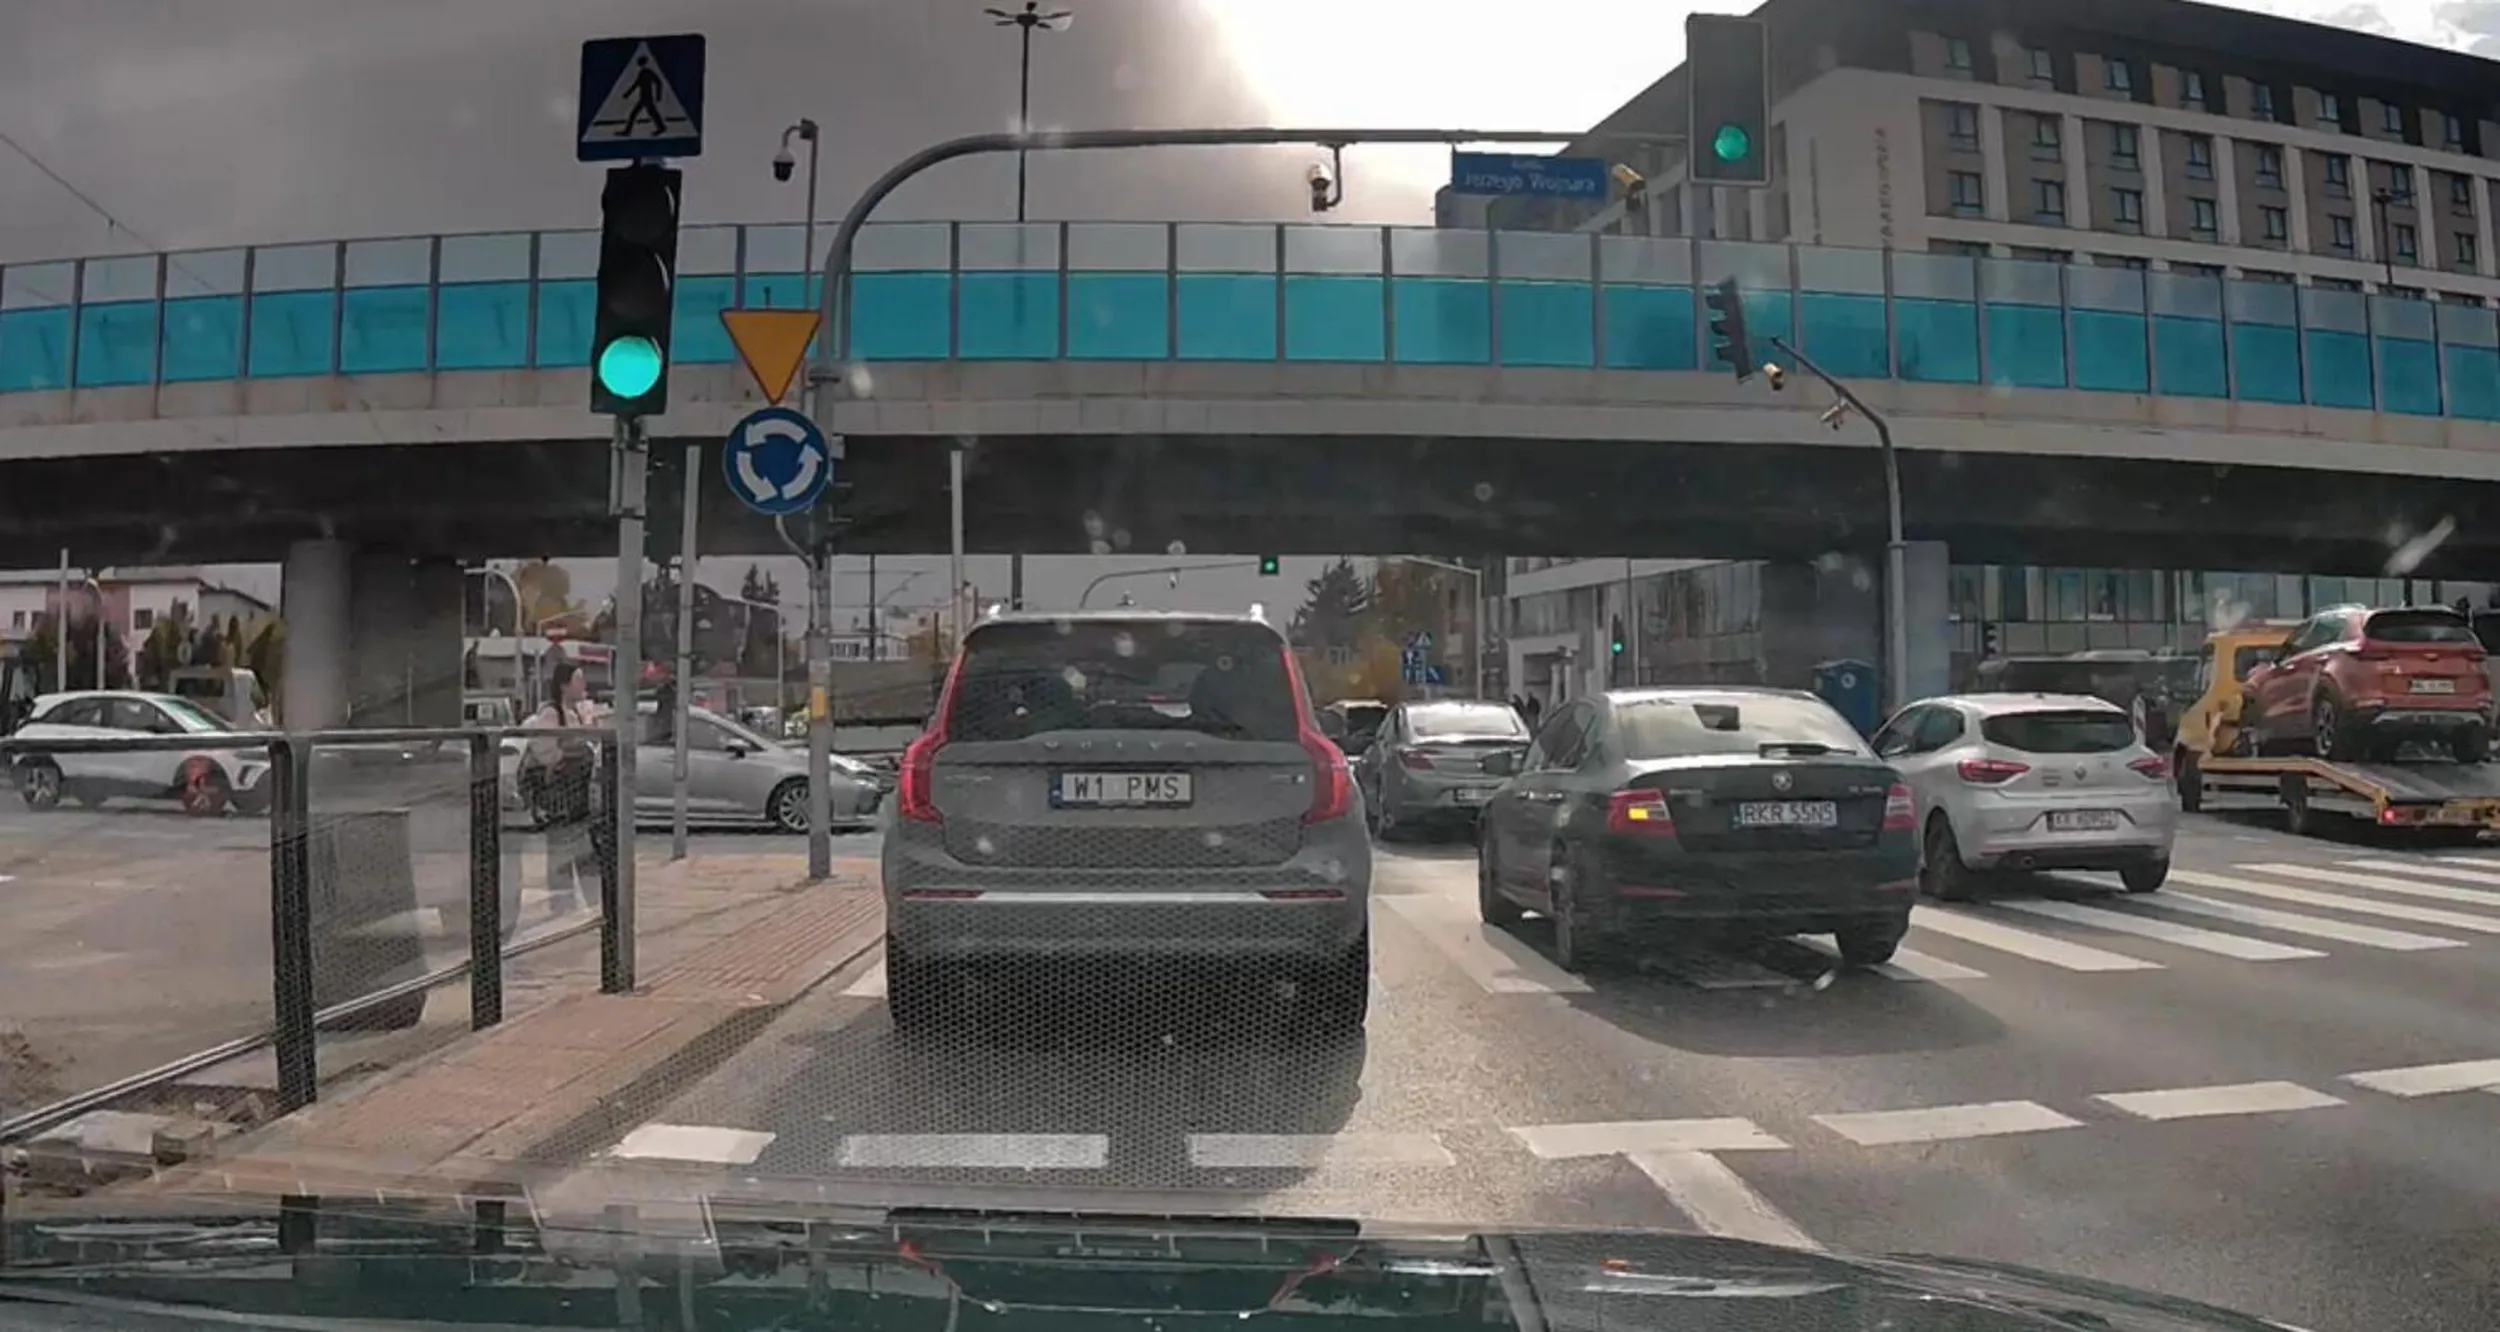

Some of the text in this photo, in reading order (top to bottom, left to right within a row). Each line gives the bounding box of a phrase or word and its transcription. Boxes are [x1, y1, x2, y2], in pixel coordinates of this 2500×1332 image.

[1074, 776, 1179, 799] W1 PMS
[1744, 803, 1783, 822] RKR
